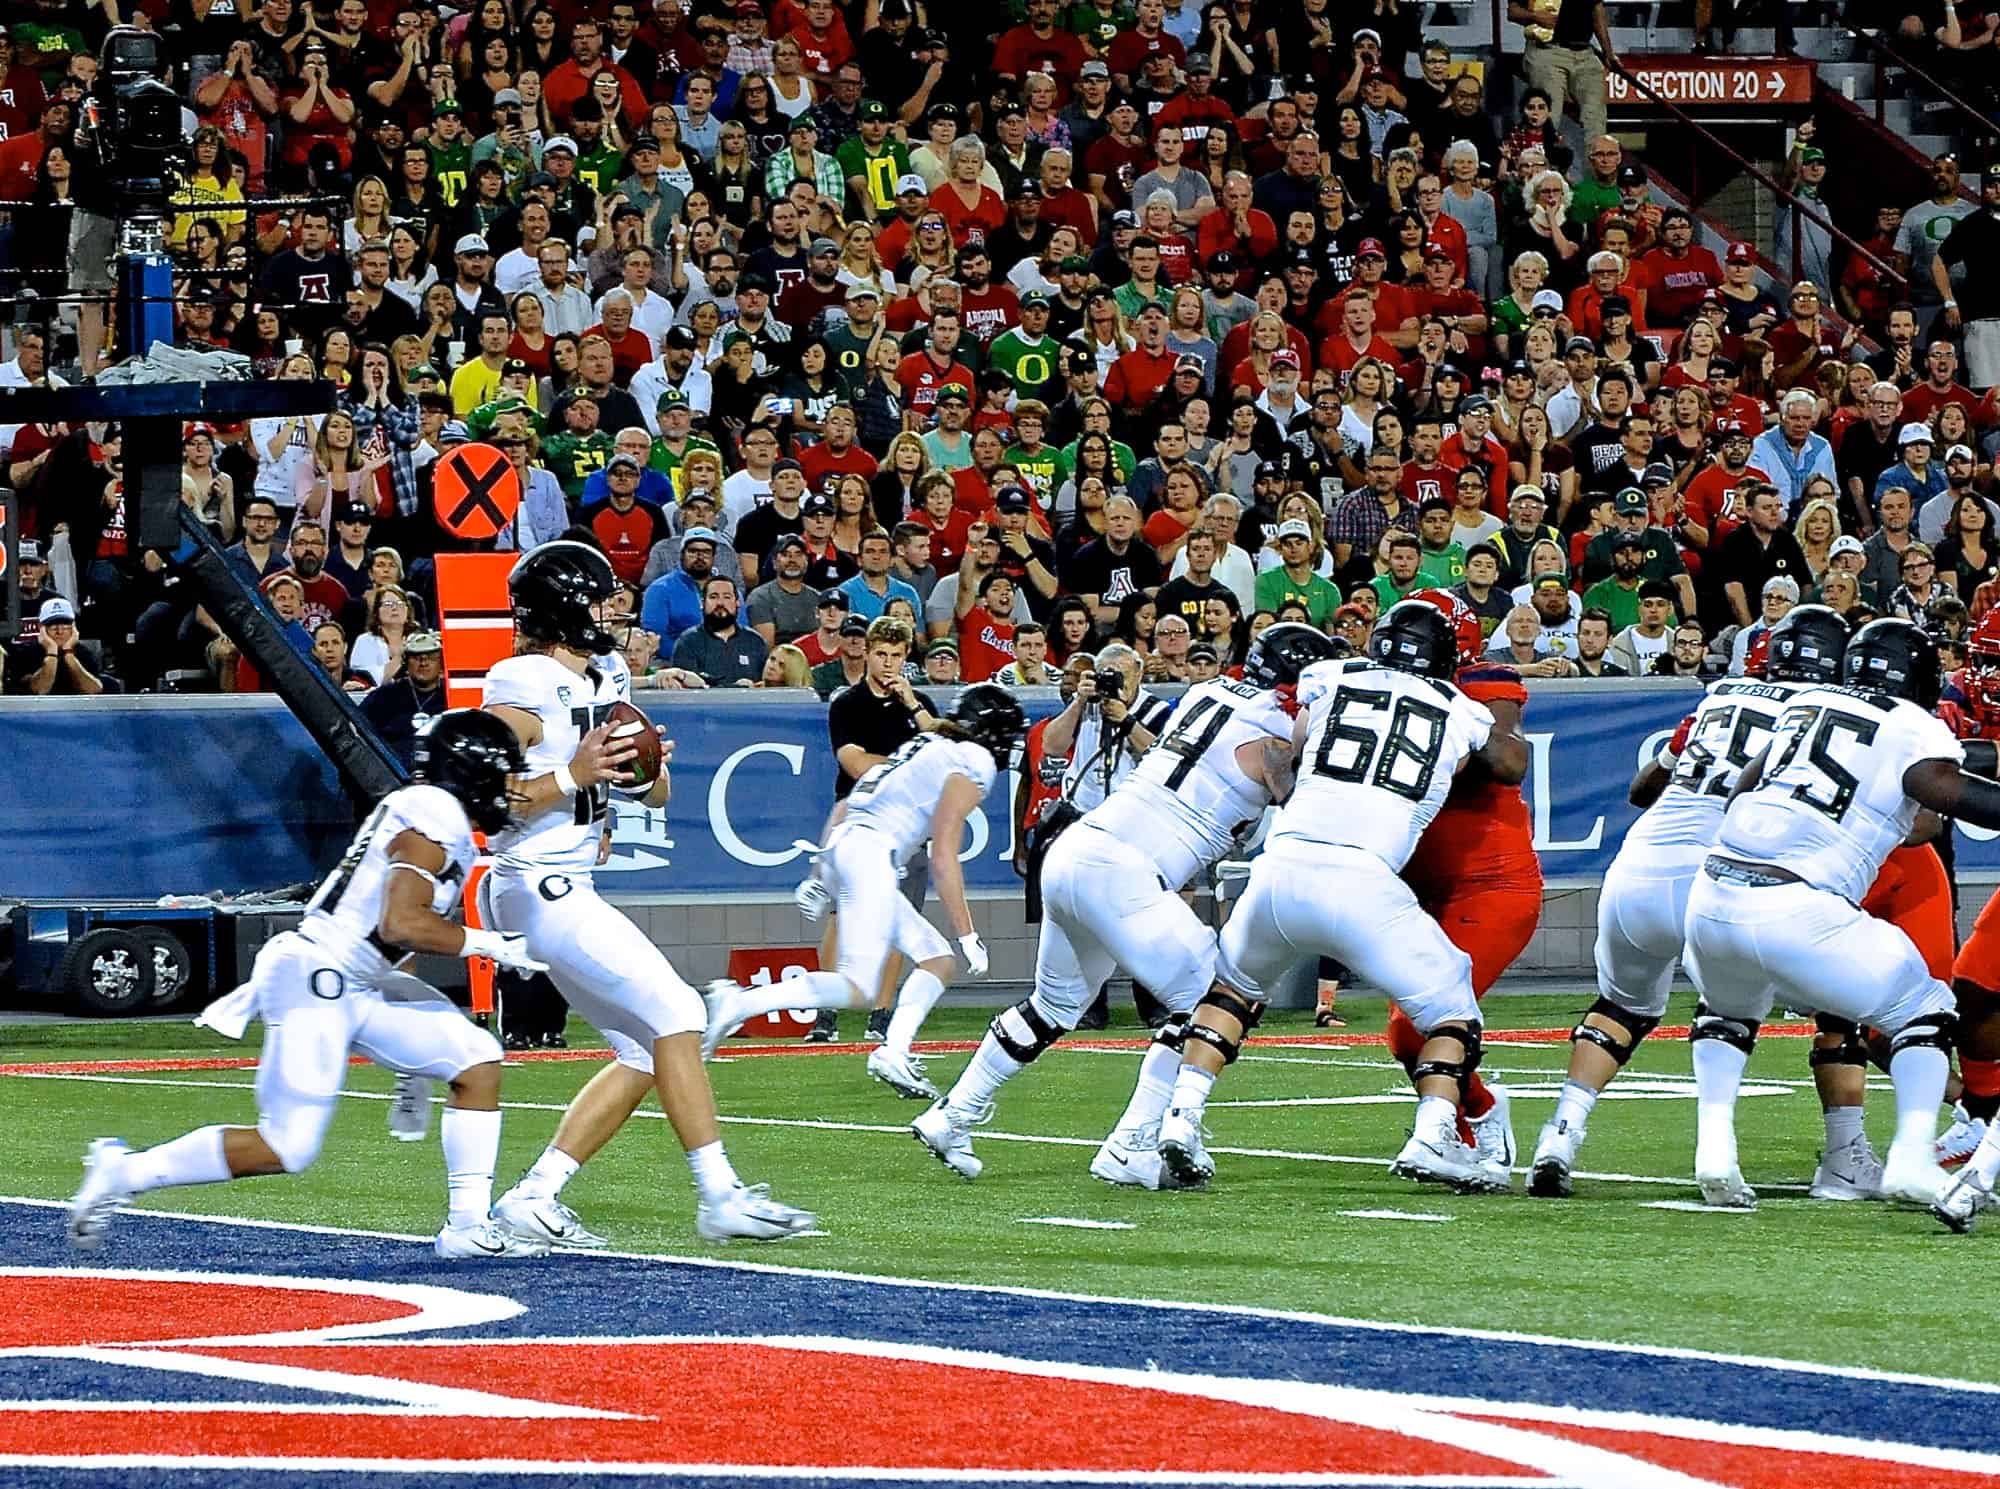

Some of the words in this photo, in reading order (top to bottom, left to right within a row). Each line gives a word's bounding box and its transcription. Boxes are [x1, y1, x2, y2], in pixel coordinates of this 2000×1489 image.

[1636, 71, 1726, 99] SECTION
[1733, 70, 1759, 98] 20
[299, 273, 329, 303] A
[840, 350, 859, 368] O
[1017, 354, 1049, 384] O
[1103, 566, 1139, 603] A
[1311, 685, 1449, 802] 68
[1762, 704, 1880, 824] 75
[311, 967, 344, 1000] O
